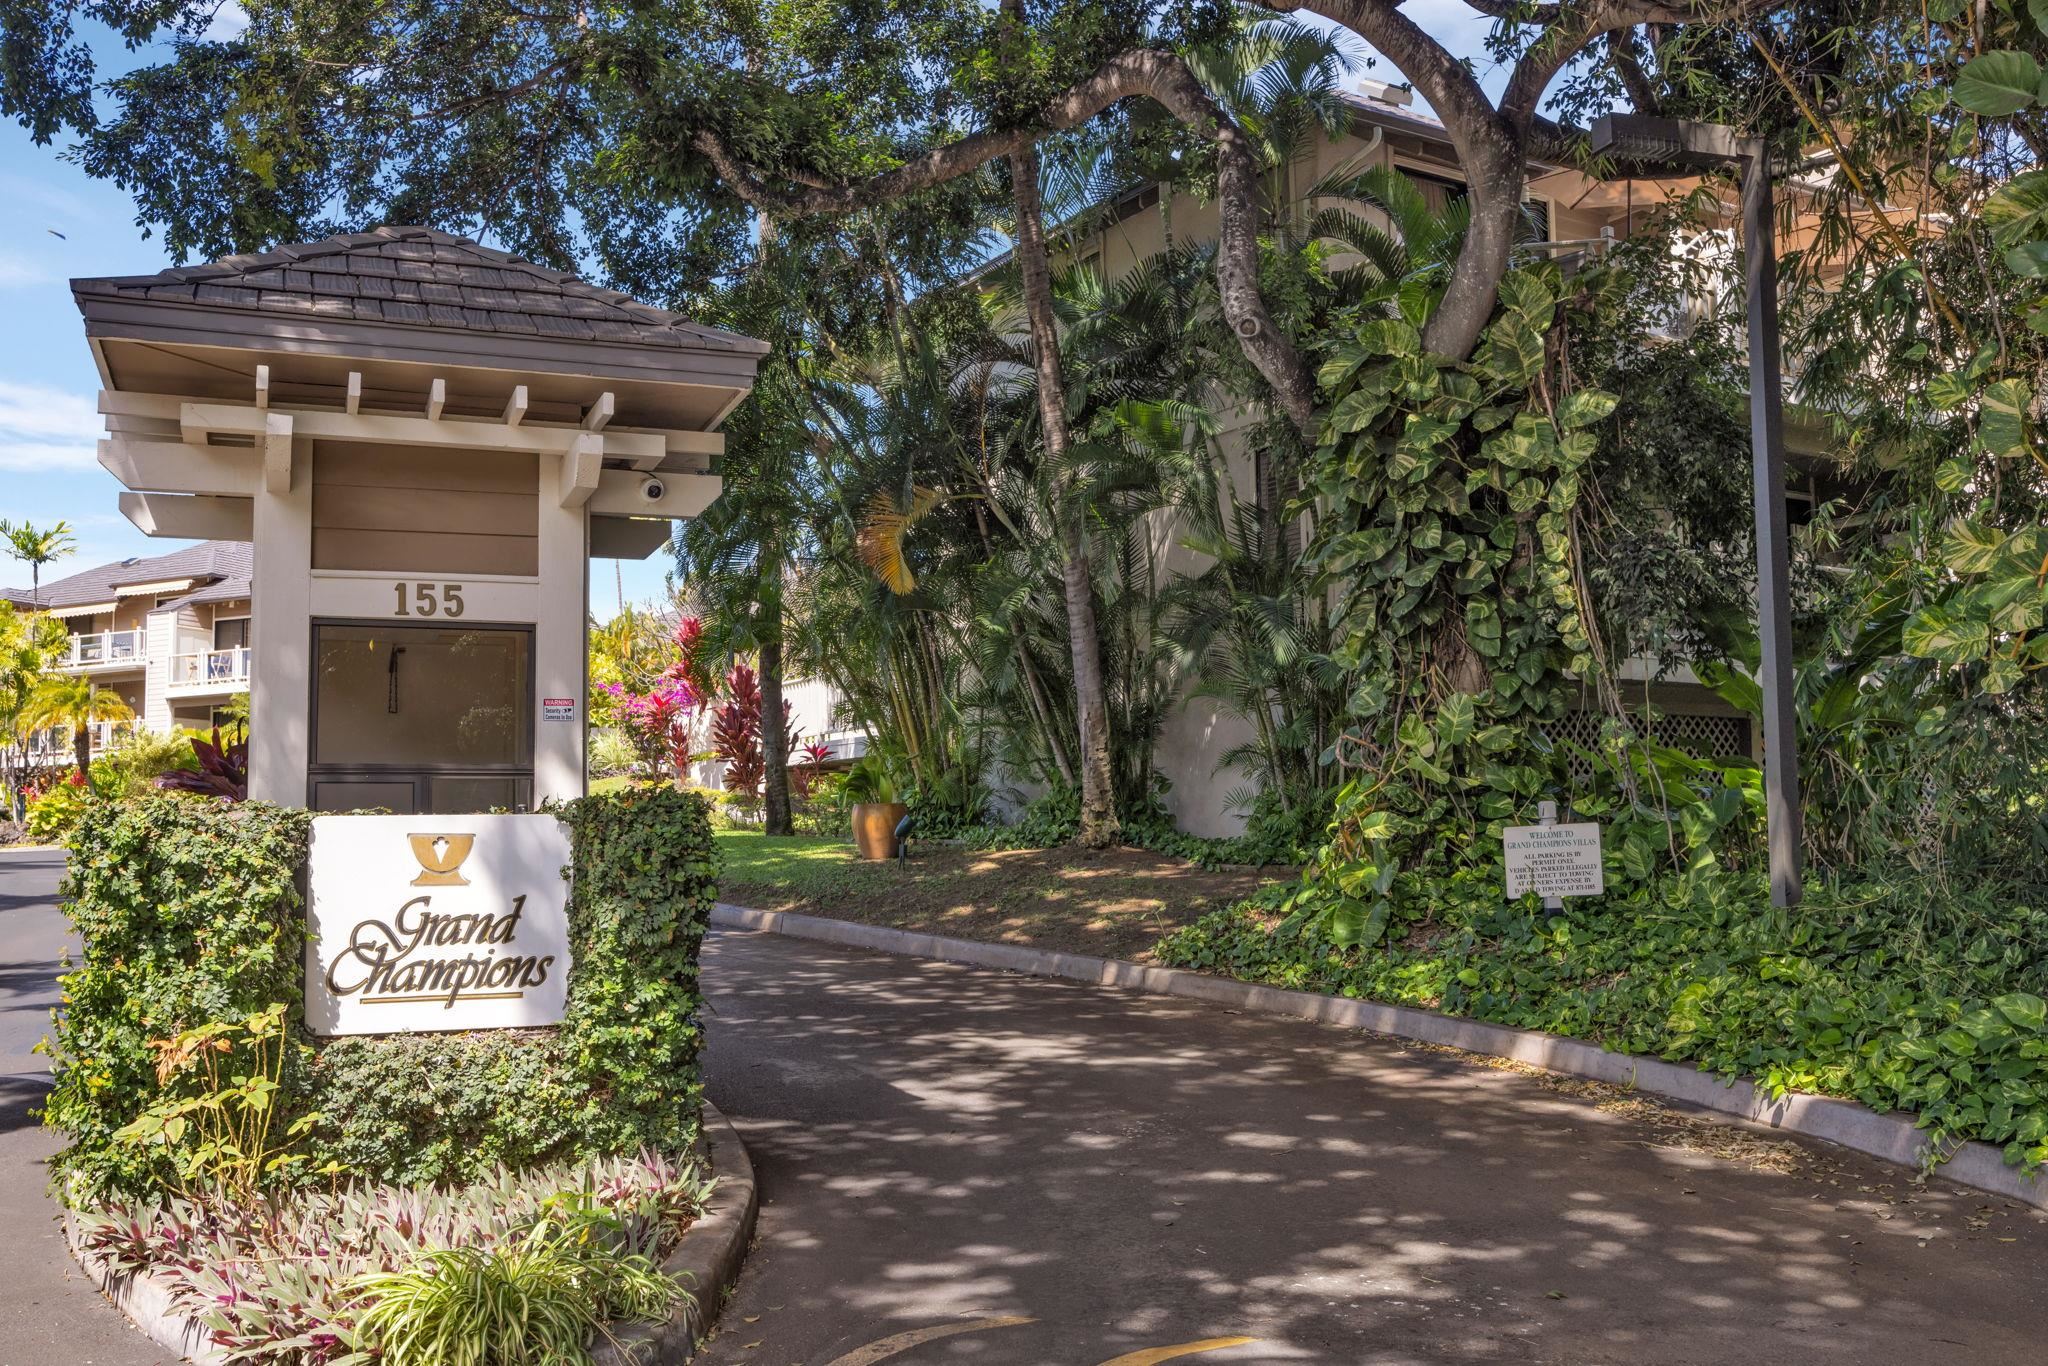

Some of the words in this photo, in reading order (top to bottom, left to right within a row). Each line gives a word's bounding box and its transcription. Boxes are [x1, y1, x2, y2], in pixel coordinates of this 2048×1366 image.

[395, 583, 464, 617] 155
[1529, 831, 1564, 839] WELCOME
[1532, 839, 1571, 848] CHAMPIONS
[1573, 838, 1596, 846] VILLAS
[394, 894, 527, 950] Grand
[325, 939, 556, 1010] Champions
